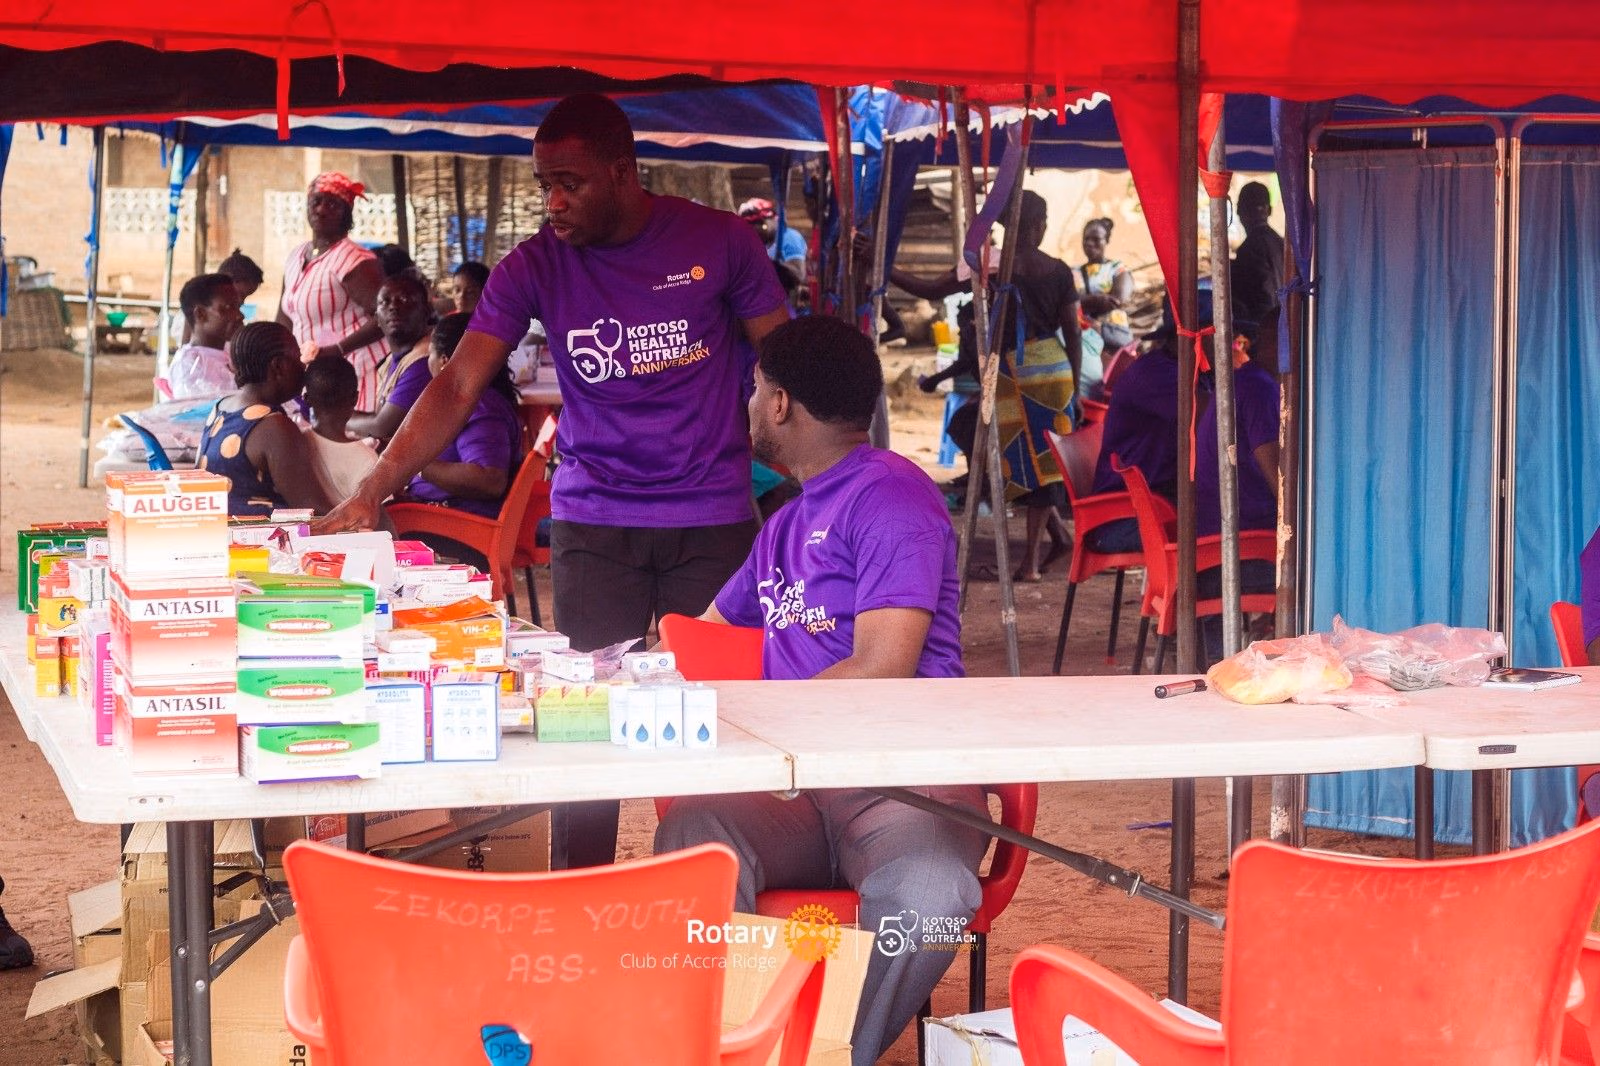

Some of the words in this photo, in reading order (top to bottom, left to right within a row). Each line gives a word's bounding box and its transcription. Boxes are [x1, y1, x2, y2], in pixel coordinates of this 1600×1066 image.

[667, 272, 690, 282] Rotary
[626, 319, 689, 339] KOTOSO
[628, 332, 687, 352] HEALTH
[630, 339, 703, 364] OUTREACH
[631, 347, 711, 376] ANNIVERSARY
[133, 496, 221, 513] ALUGEL
[143, 600, 225, 616] ANTASIL
[146, 697, 226, 713] ANTASIL
[373, 887, 556, 935] ZEKORPE
[582, 897, 699, 933] YOUTH
[490, 1043, 527, 1060] DPS
